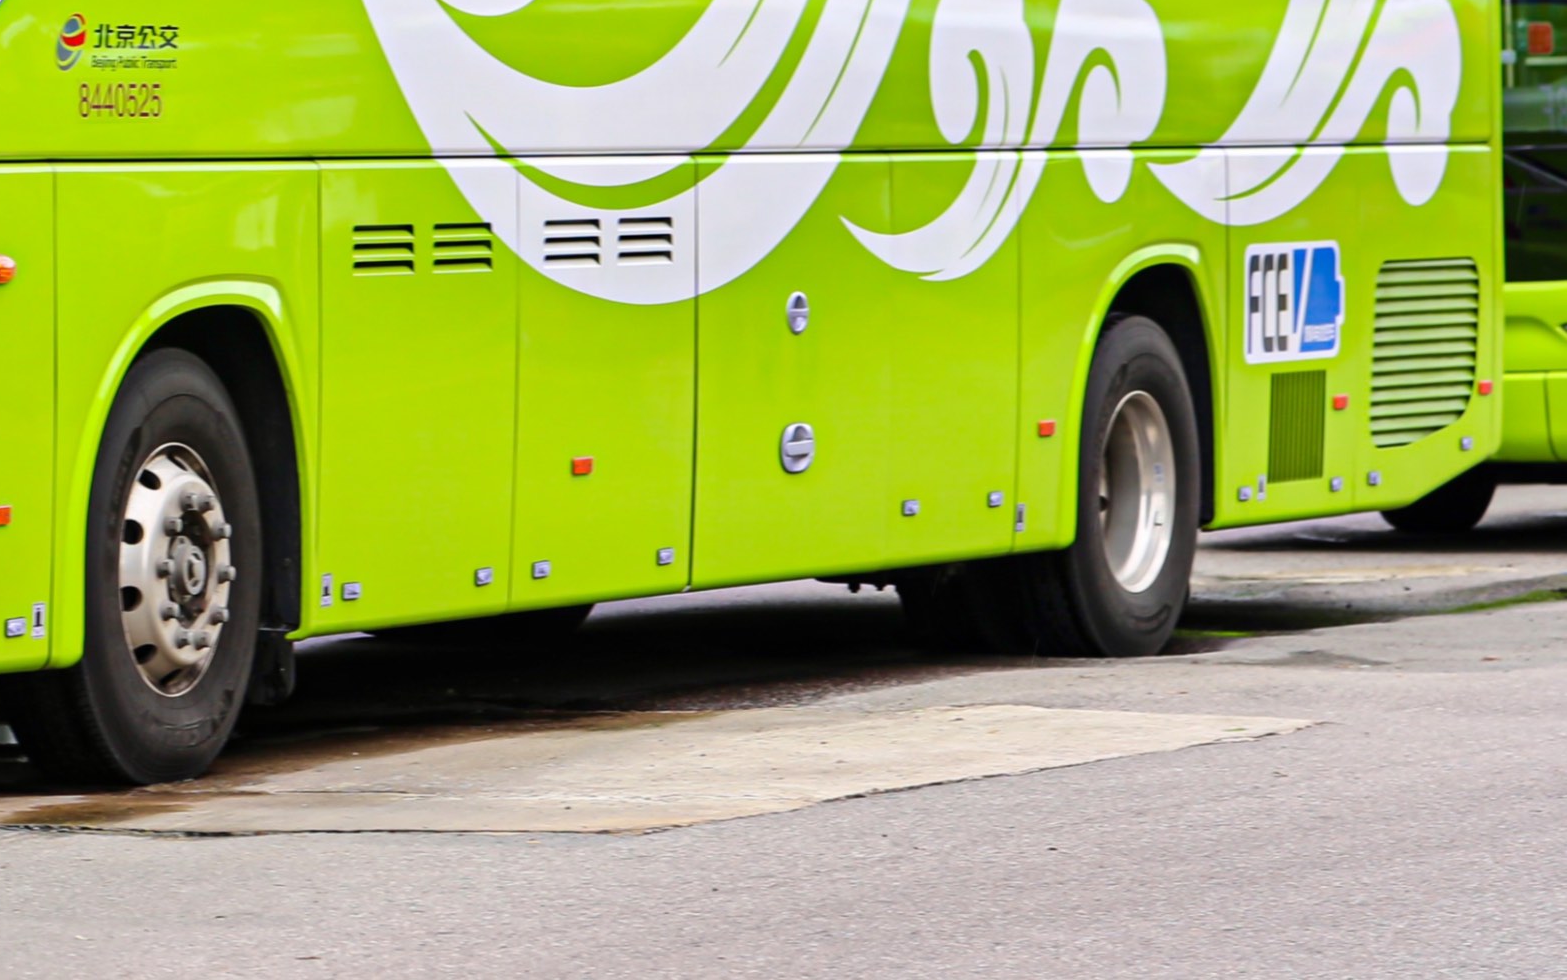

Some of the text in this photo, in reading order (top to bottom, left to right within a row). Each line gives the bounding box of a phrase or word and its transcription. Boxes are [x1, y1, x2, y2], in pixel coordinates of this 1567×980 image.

[93, 24, 179, 49] 北京公交
[78, 83, 163, 118] 8440525
